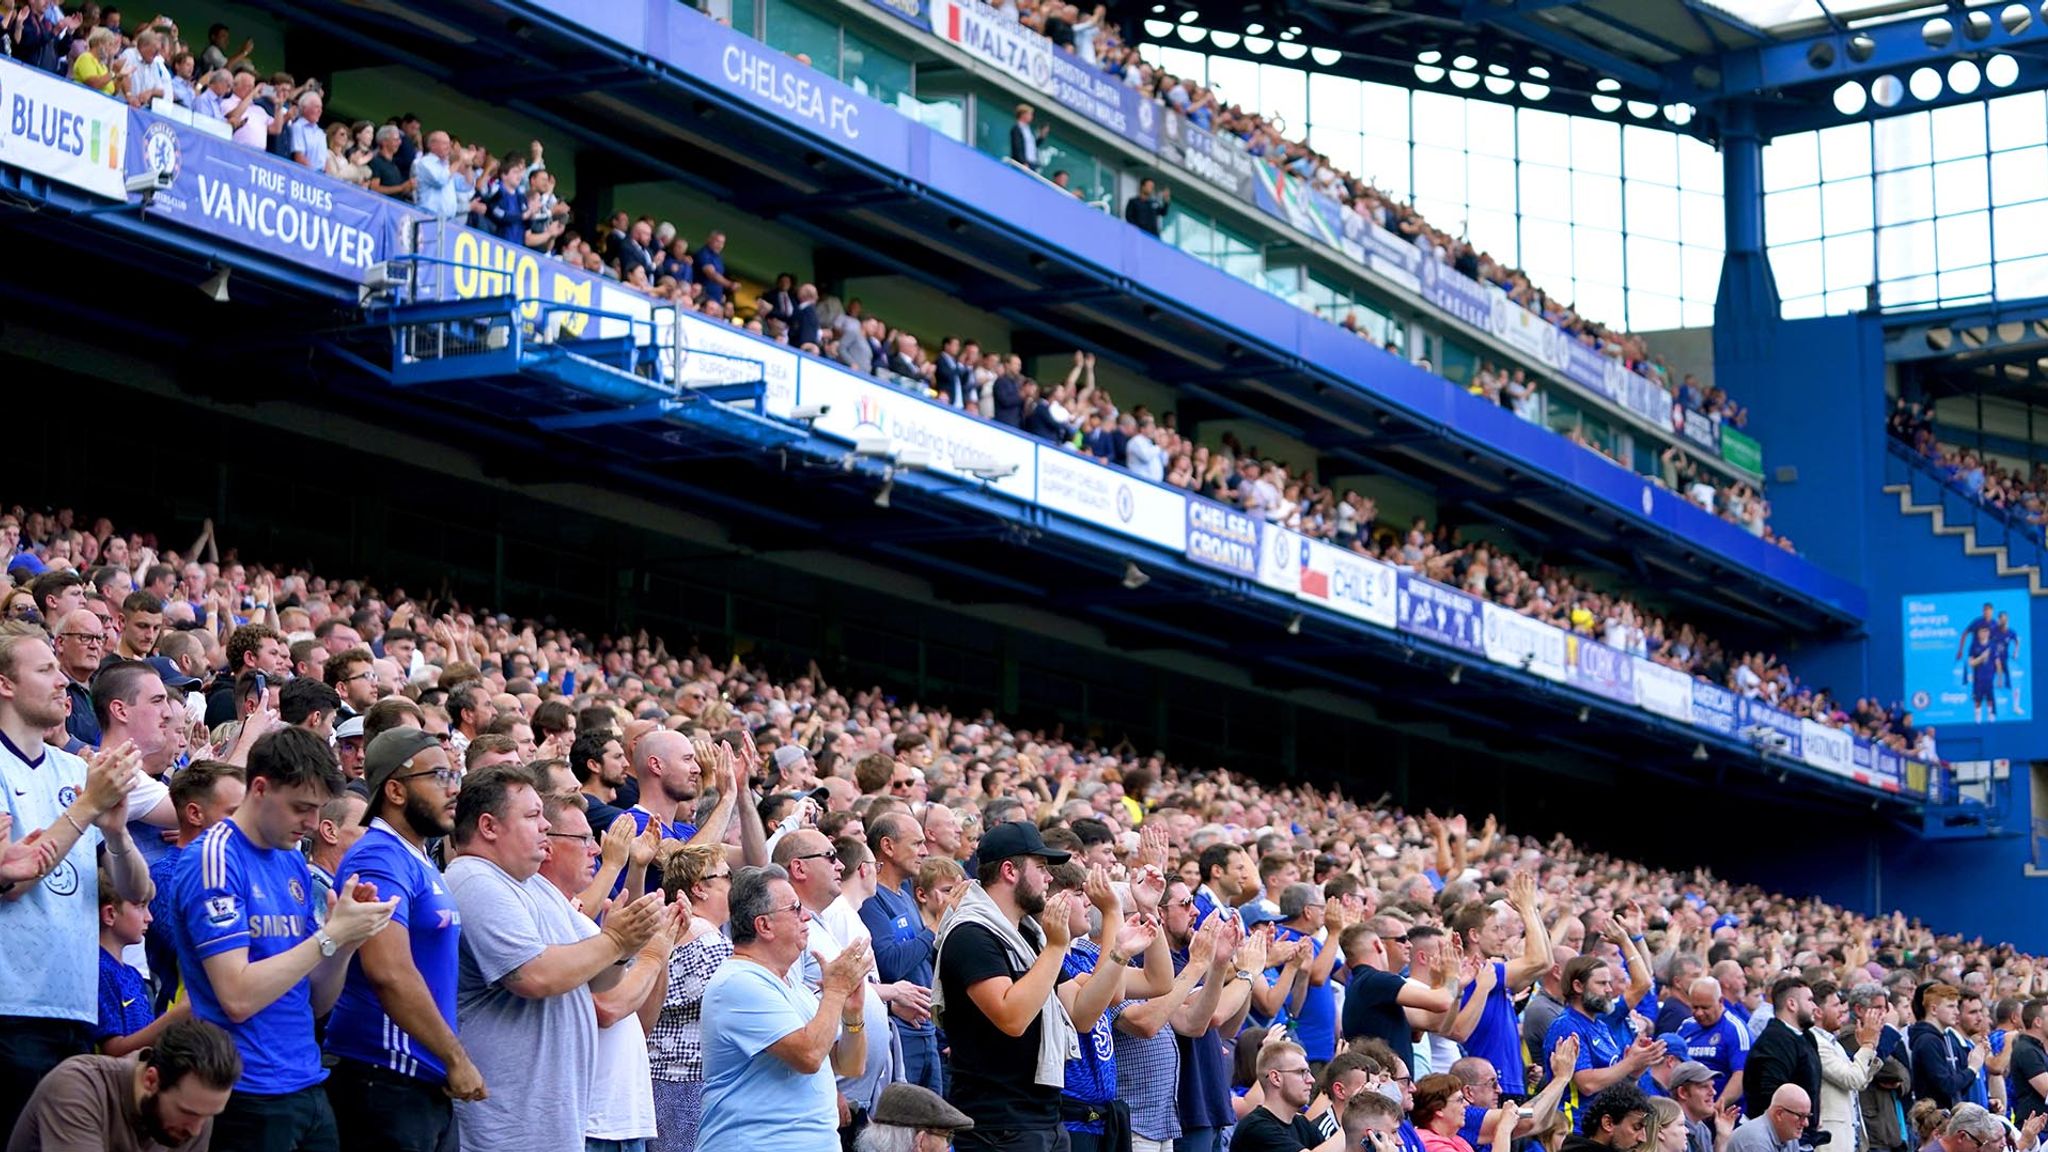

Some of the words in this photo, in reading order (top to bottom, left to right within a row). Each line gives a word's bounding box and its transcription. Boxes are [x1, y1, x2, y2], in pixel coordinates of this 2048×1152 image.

[965, 17, 1030, 75] MALTA
[723, 45, 826, 125] CHELSEA
[830, 95, 860, 139] FC
[1061, 81, 1095, 113] SOUTH
[1095, 101, 1127, 132] WALES
[11, 93, 84, 157] BLUES
[249, 163, 286, 194] TRUE
[290, 180, 333, 212] BLUES
[198, 174, 375, 269] VANCOUVER
[454, 232, 540, 320] OHIO
[892, 414, 944, 460] building
[1189, 501, 1257, 545] CHELSEA
[1190, 530, 1256, 573] CROATIA
[1333, 569, 1374, 607] CHILE
[1909, 602, 1935, 613] Blue
[1909, 615, 1949, 626] always
[1909, 627, 1957, 639] delivers.
